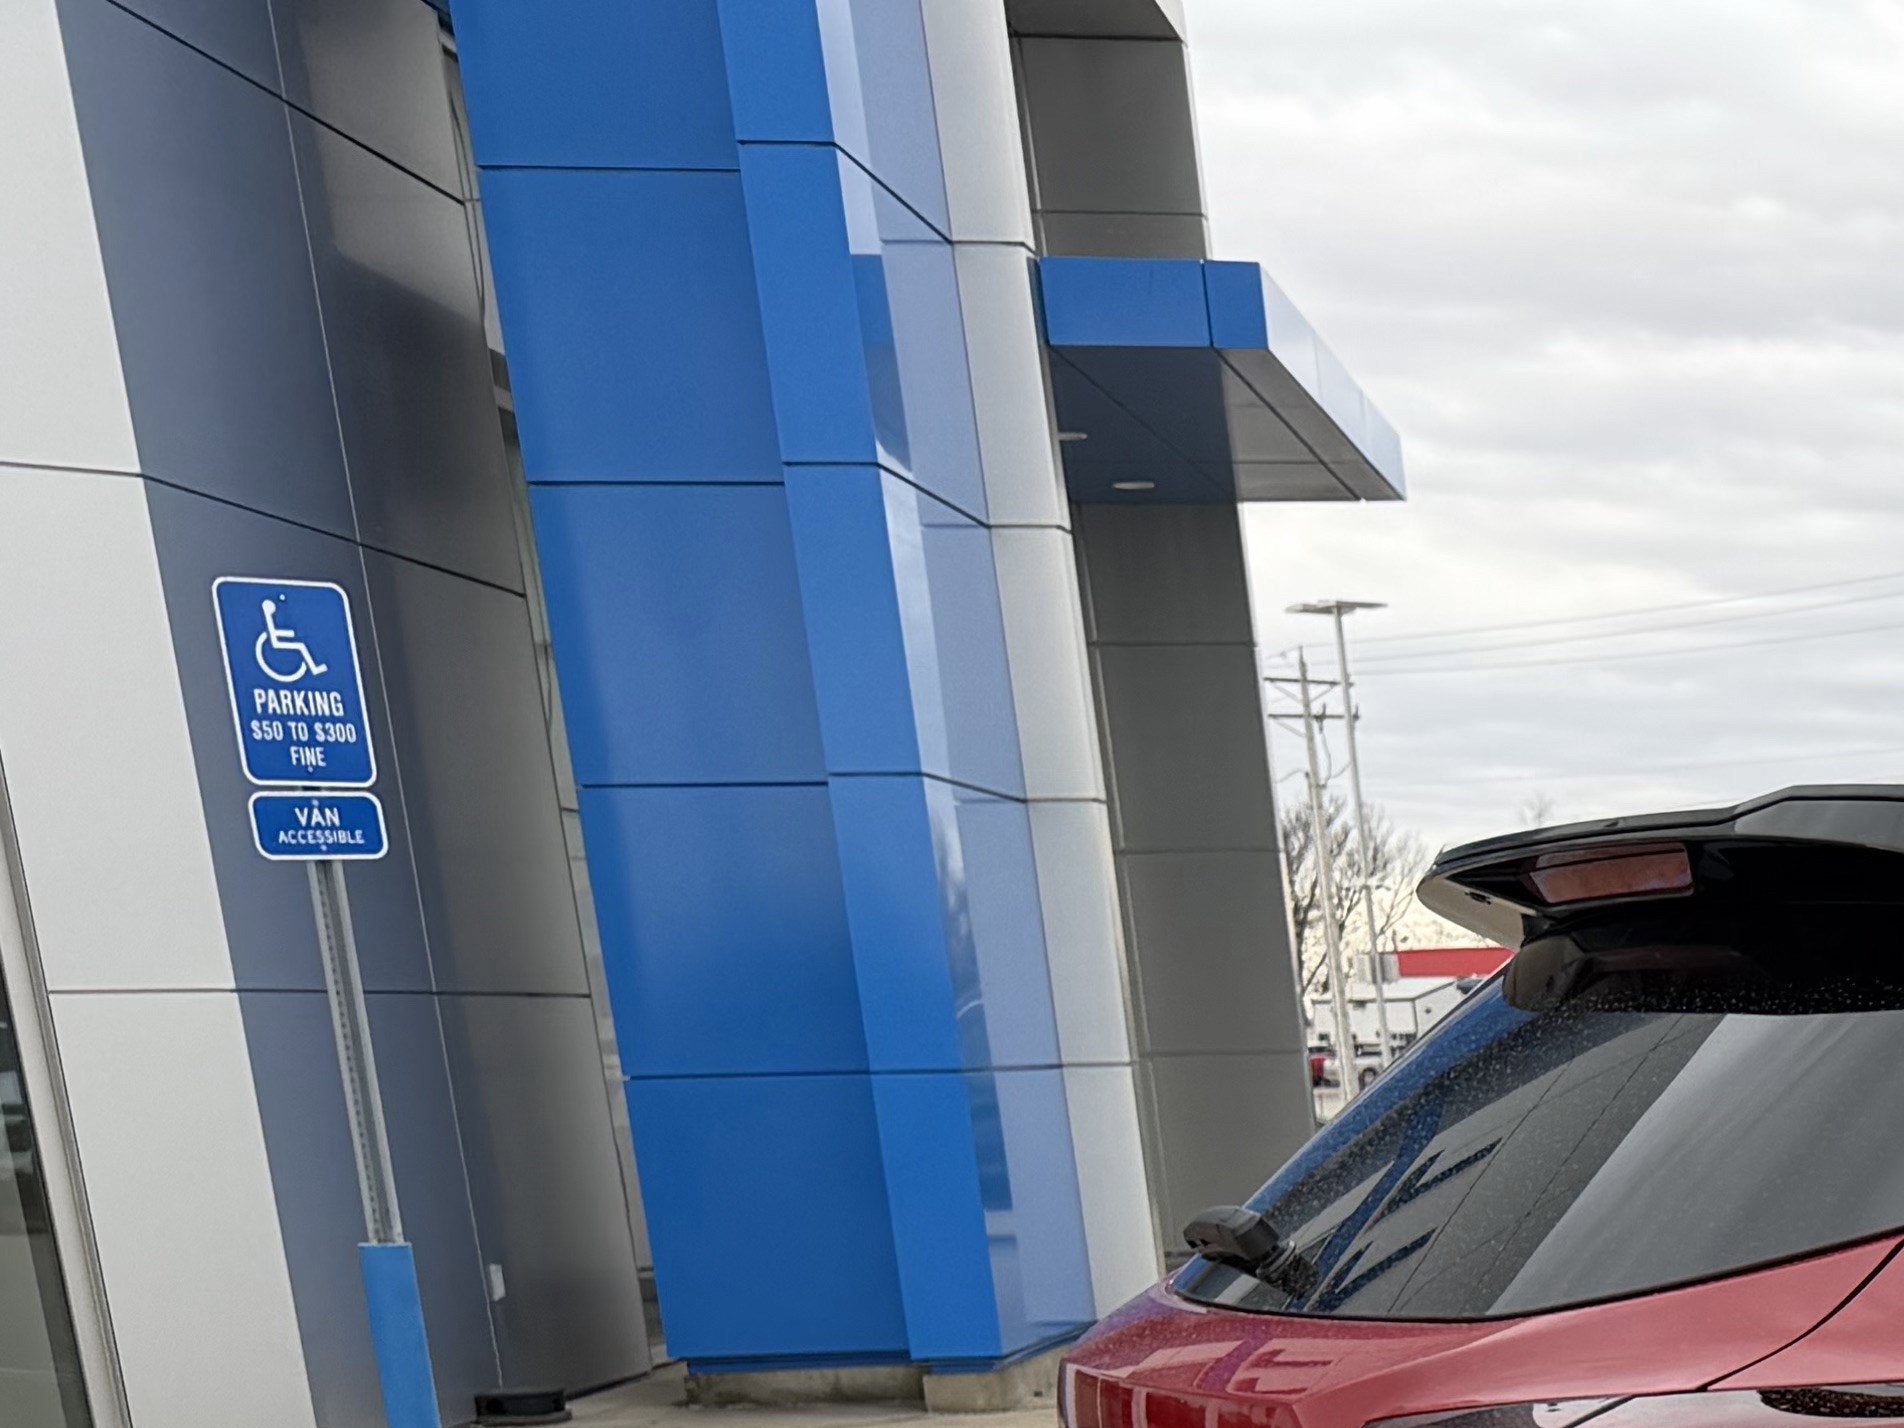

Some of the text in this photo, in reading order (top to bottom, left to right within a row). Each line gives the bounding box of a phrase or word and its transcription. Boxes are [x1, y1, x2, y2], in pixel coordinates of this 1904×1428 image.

[253, 689, 344, 717] PARKING
[251, 720, 357, 743] $50 TO $300
[290, 746, 326, 767] FINE
[294, 807, 340, 827] VAN
[278, 829, 365, 845] ACCESSIBLE
